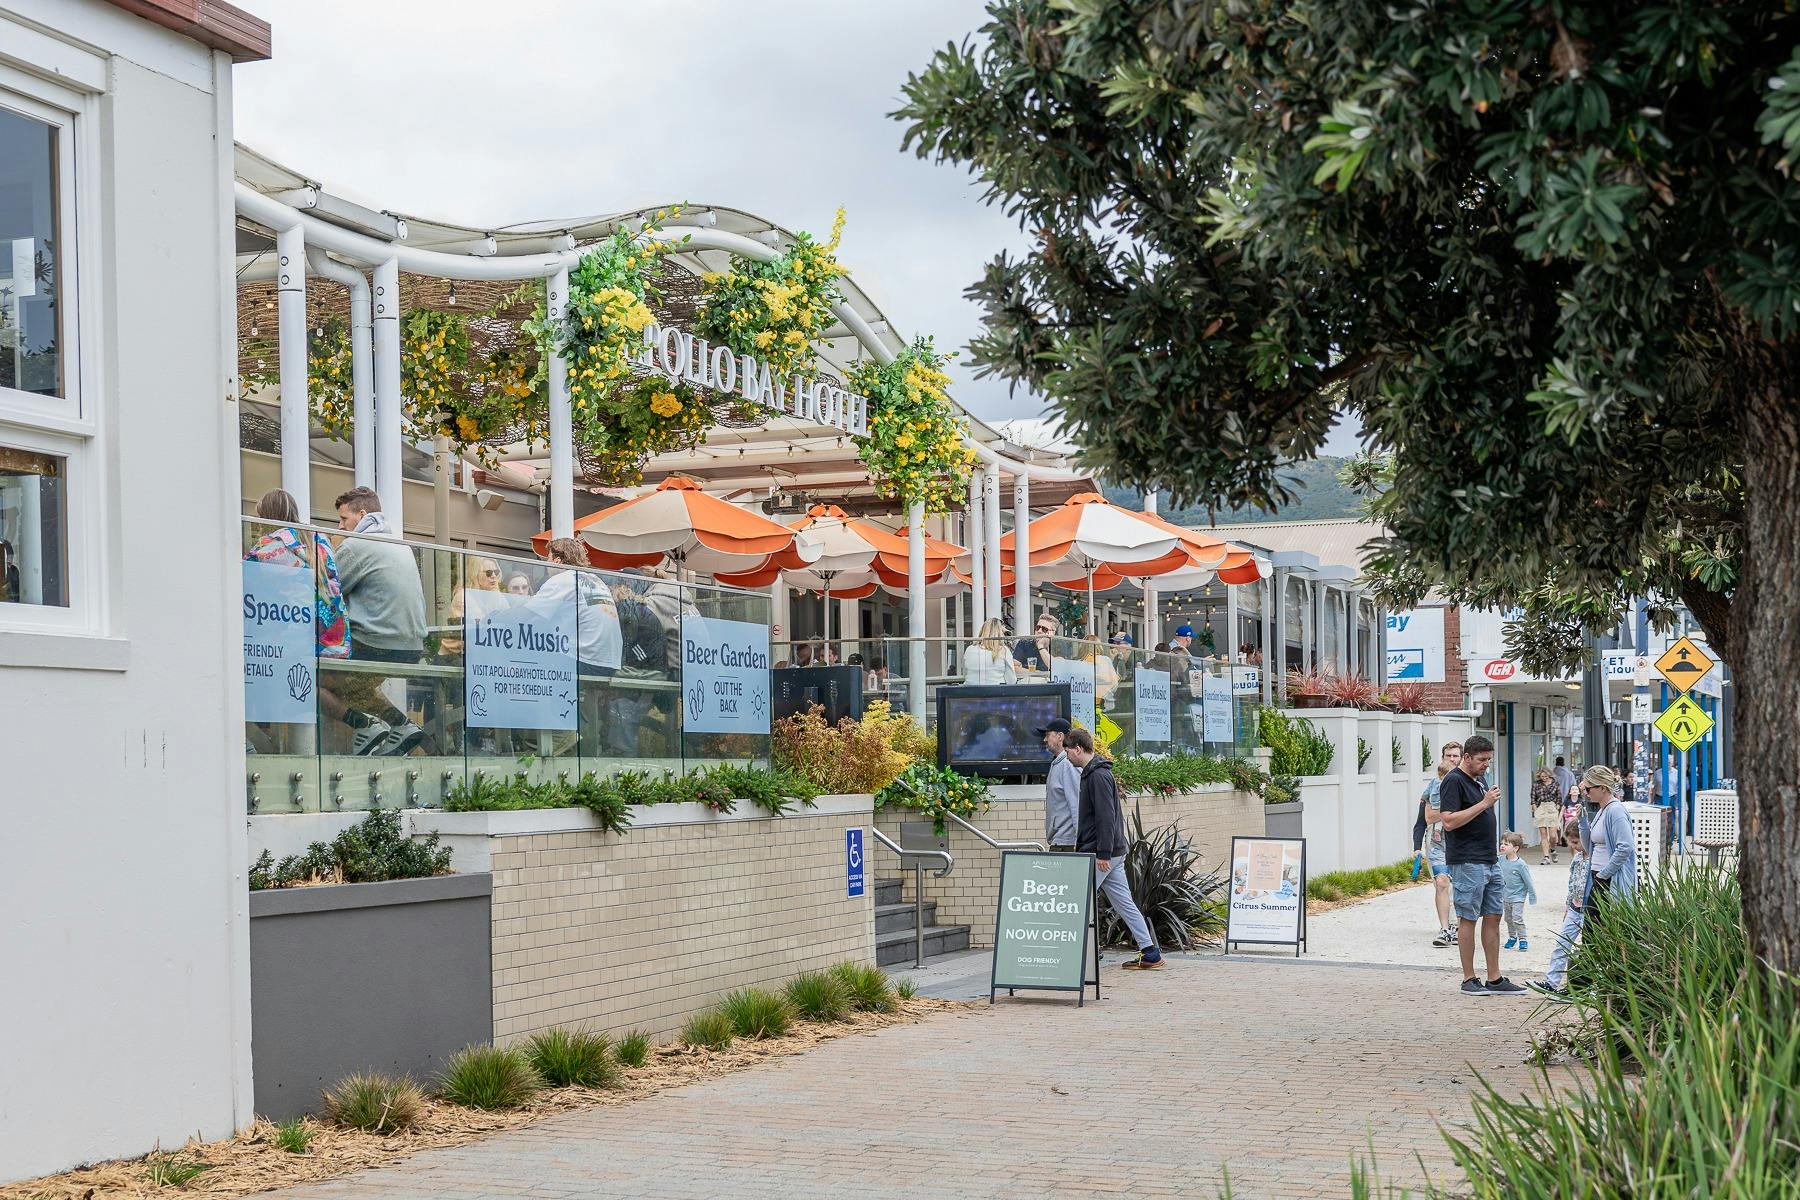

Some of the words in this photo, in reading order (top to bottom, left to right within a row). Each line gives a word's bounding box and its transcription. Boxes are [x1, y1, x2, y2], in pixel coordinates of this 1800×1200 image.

[624, 325, 736, 394] POLLO
[794, 373, 872, 437] HOTEL
[244, 594, 312, 626] Spaces
[474, 618, 513, 649] Live
[517, 623, 570, 654] Music
[686, 640, 718, 665] Beer
[720, 643, 768, 670] Garden
[244, 664, 274, 678] ETAILS
[472, 664, 488, 676] VISIT
[490, 666, 572, 682] APOLLOBAYHOTEL.COM.AU
[1488, 664, 1510, 676] IGA
[494, 682, 508, 694] FOR
[509, 683, 520, 694] THE
[522, 684, 552, 696] SCHEDULE
[714, 681, 730, 695] OUT
[730, 682, 742, 696] THE
[1070, 676, 1093, 694] Garden
[1140, 683, 1150, 699] Live
[1152, 684, 1167, 700] Music
[720, 698, 738, 712] BACK
[1022, 880, 1068, 896] Beer
[1008, 896, 1080, 914] Garden
[1232, 902, 1259, 910] Citrus
[1260, 903, 1297, 911] Summer
[1006, 928, 1039, 940] NOW
[1042, 930, 1077, 942] OPEN
